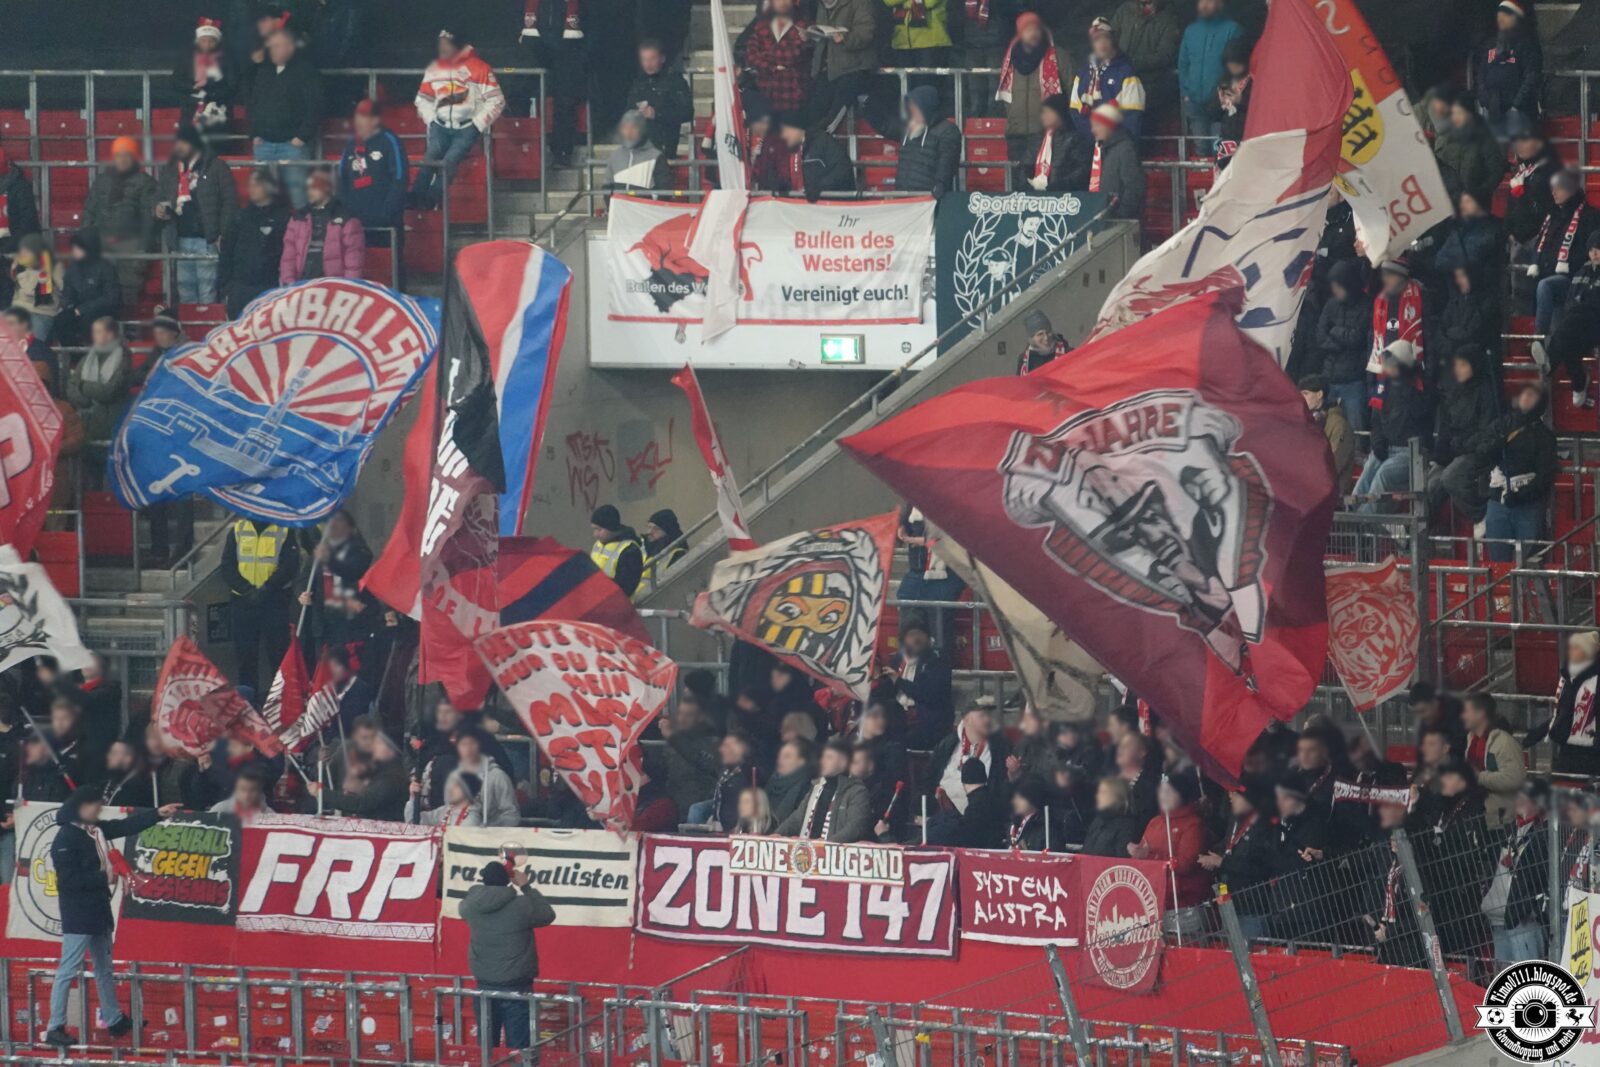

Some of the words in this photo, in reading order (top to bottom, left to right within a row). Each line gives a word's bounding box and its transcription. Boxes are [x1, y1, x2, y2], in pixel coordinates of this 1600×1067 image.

[969, 192, 1080, 216] Sportfreunde
[837, 215, 860, 228] Ihr
[795, 231, 854, 249] Bullen
[861, 231, 894, 249] des
[802, 254, 892, 272] Westens!
[668, 281, 690, 294] des
[782, 286, 859, 305] Vereinigt
[864, 284, 908, 301] euch!
[152, 850, 211, 880] GEGEN
[731, 840, 788, 871] ZONE
[817, 845, 903, 879] JUGEND
[238, 832, 437, 921] FRP
[972, 871, 1068, 902] SYSTEMA
[648, 846, 826, 937] ZONE
[974, 900, 1067, 931] ALISTRA
